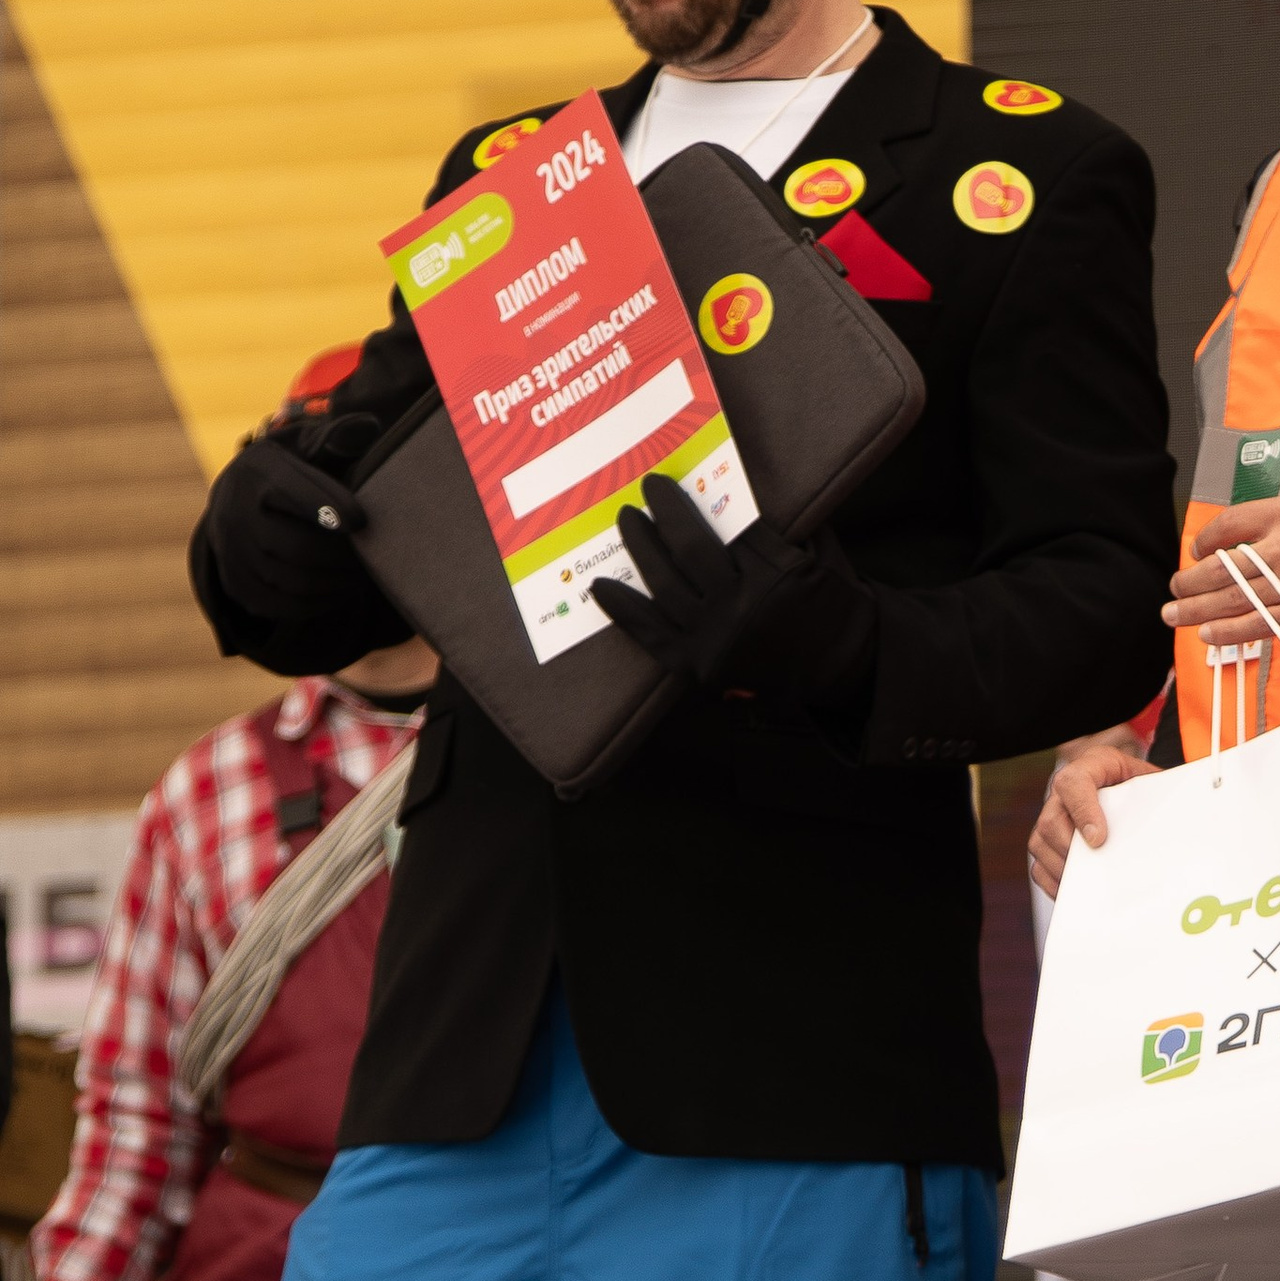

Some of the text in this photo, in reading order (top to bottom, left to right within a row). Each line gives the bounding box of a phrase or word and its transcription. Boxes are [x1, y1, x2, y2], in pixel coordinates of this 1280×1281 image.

[536, 129, 607, 204] 2024
[494, 236, 588, 323] ДИПЛОМ
[473, 283, 658, 426] Приз зрительских
[530, 340, 634, 428] симпатий
